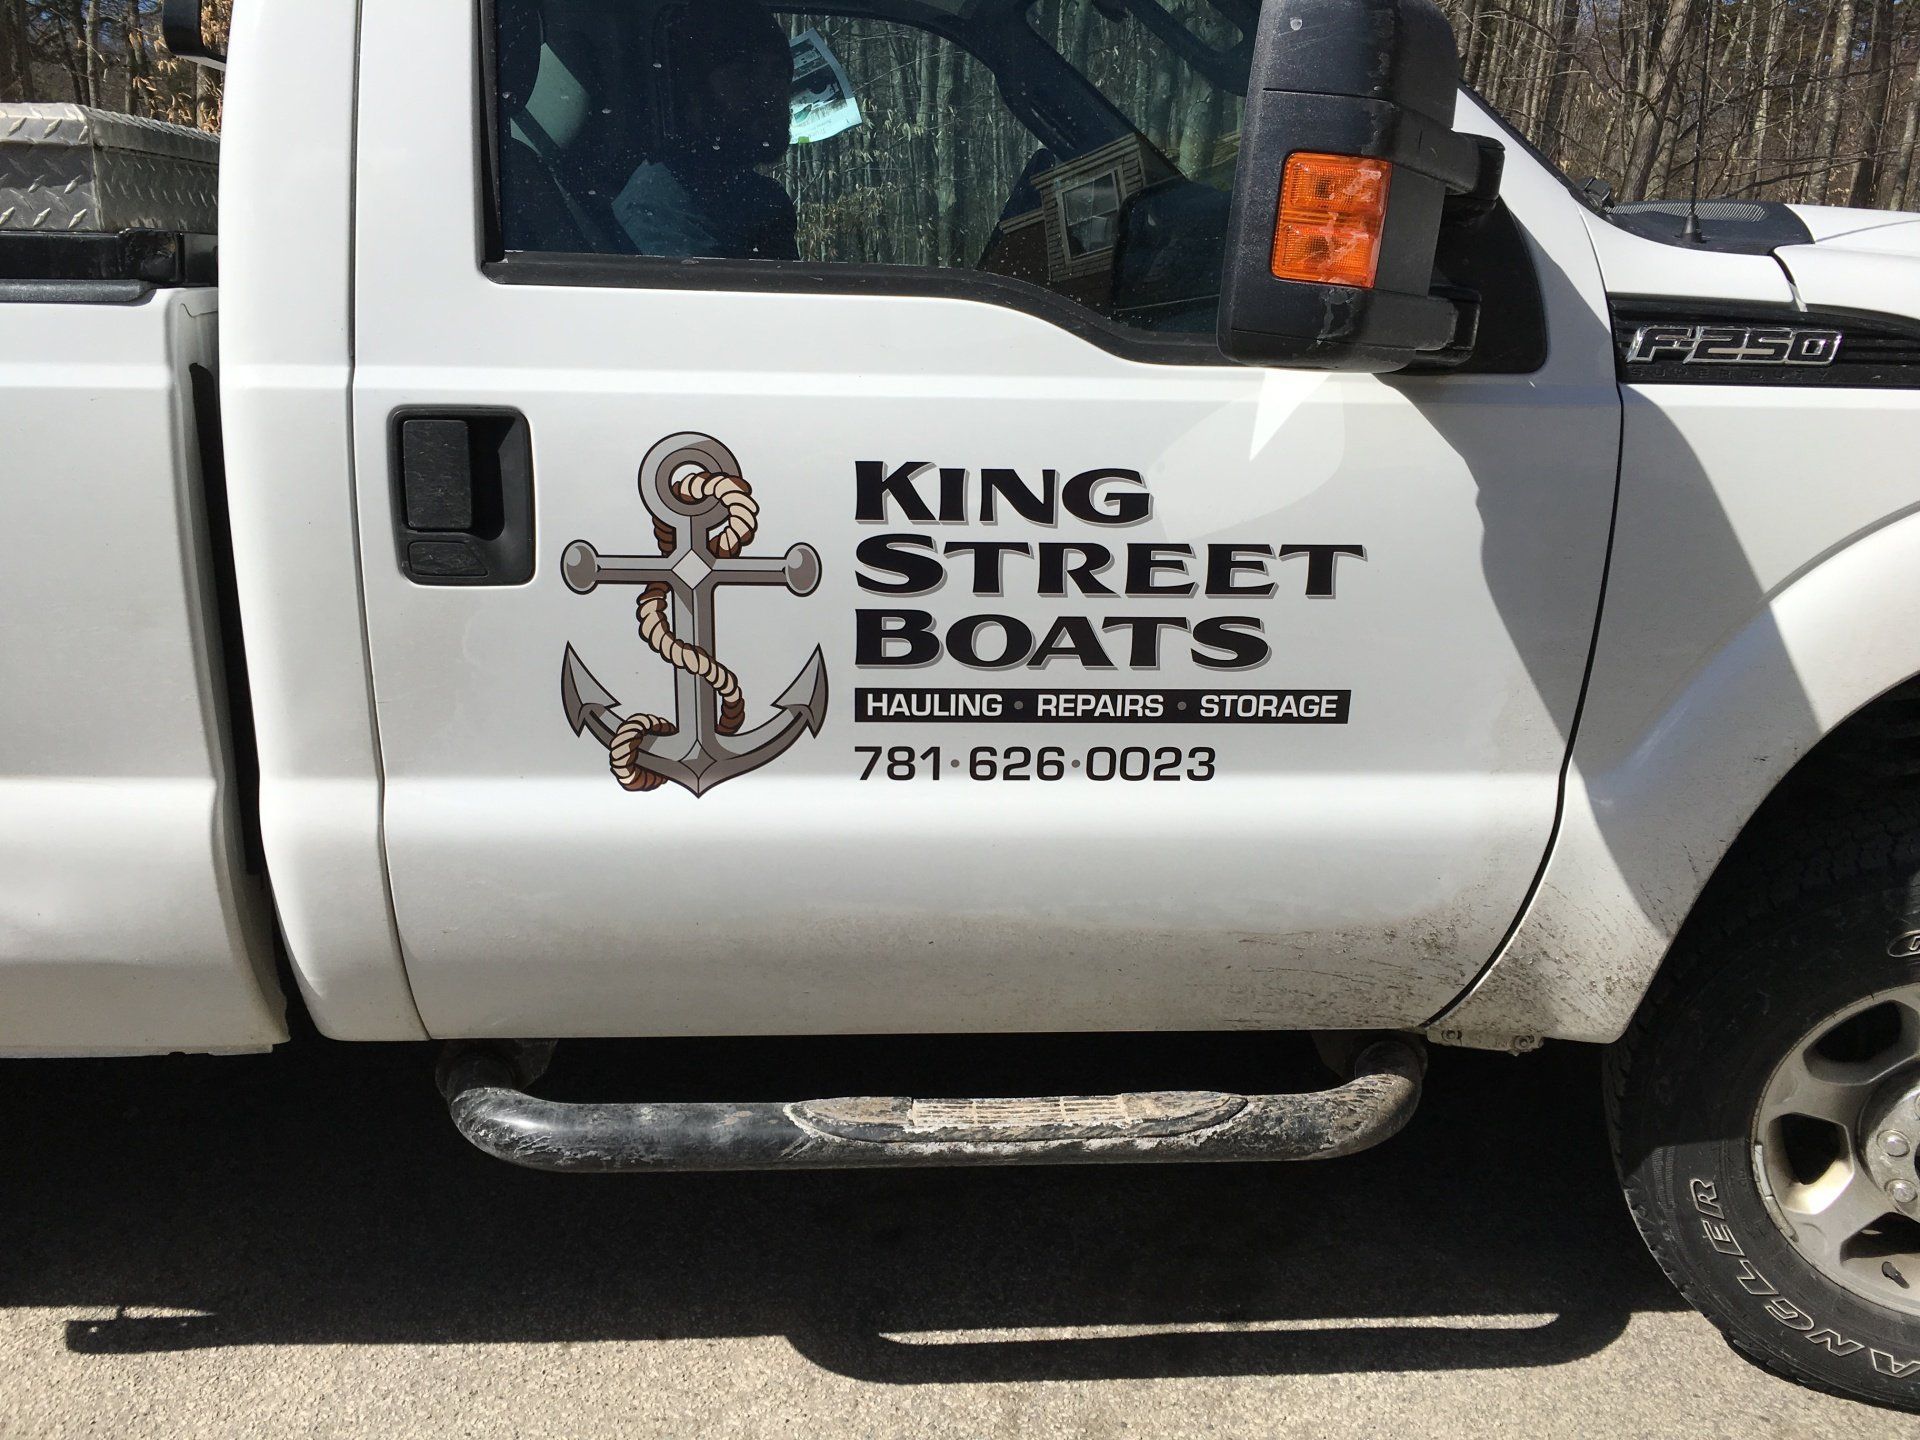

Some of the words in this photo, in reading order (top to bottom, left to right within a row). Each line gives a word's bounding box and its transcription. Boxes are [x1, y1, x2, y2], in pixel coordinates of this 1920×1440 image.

[854, 460, 1153, 528] KING
[854, 533, 1367, 600] STREET
[854, 608, 1273, 671] BOATS
[866, 693, 1003, 717] HAULING
[1037, 694, 1163, 717] REPAIRS
[1199, 695, 1338, 718] STORAGE
